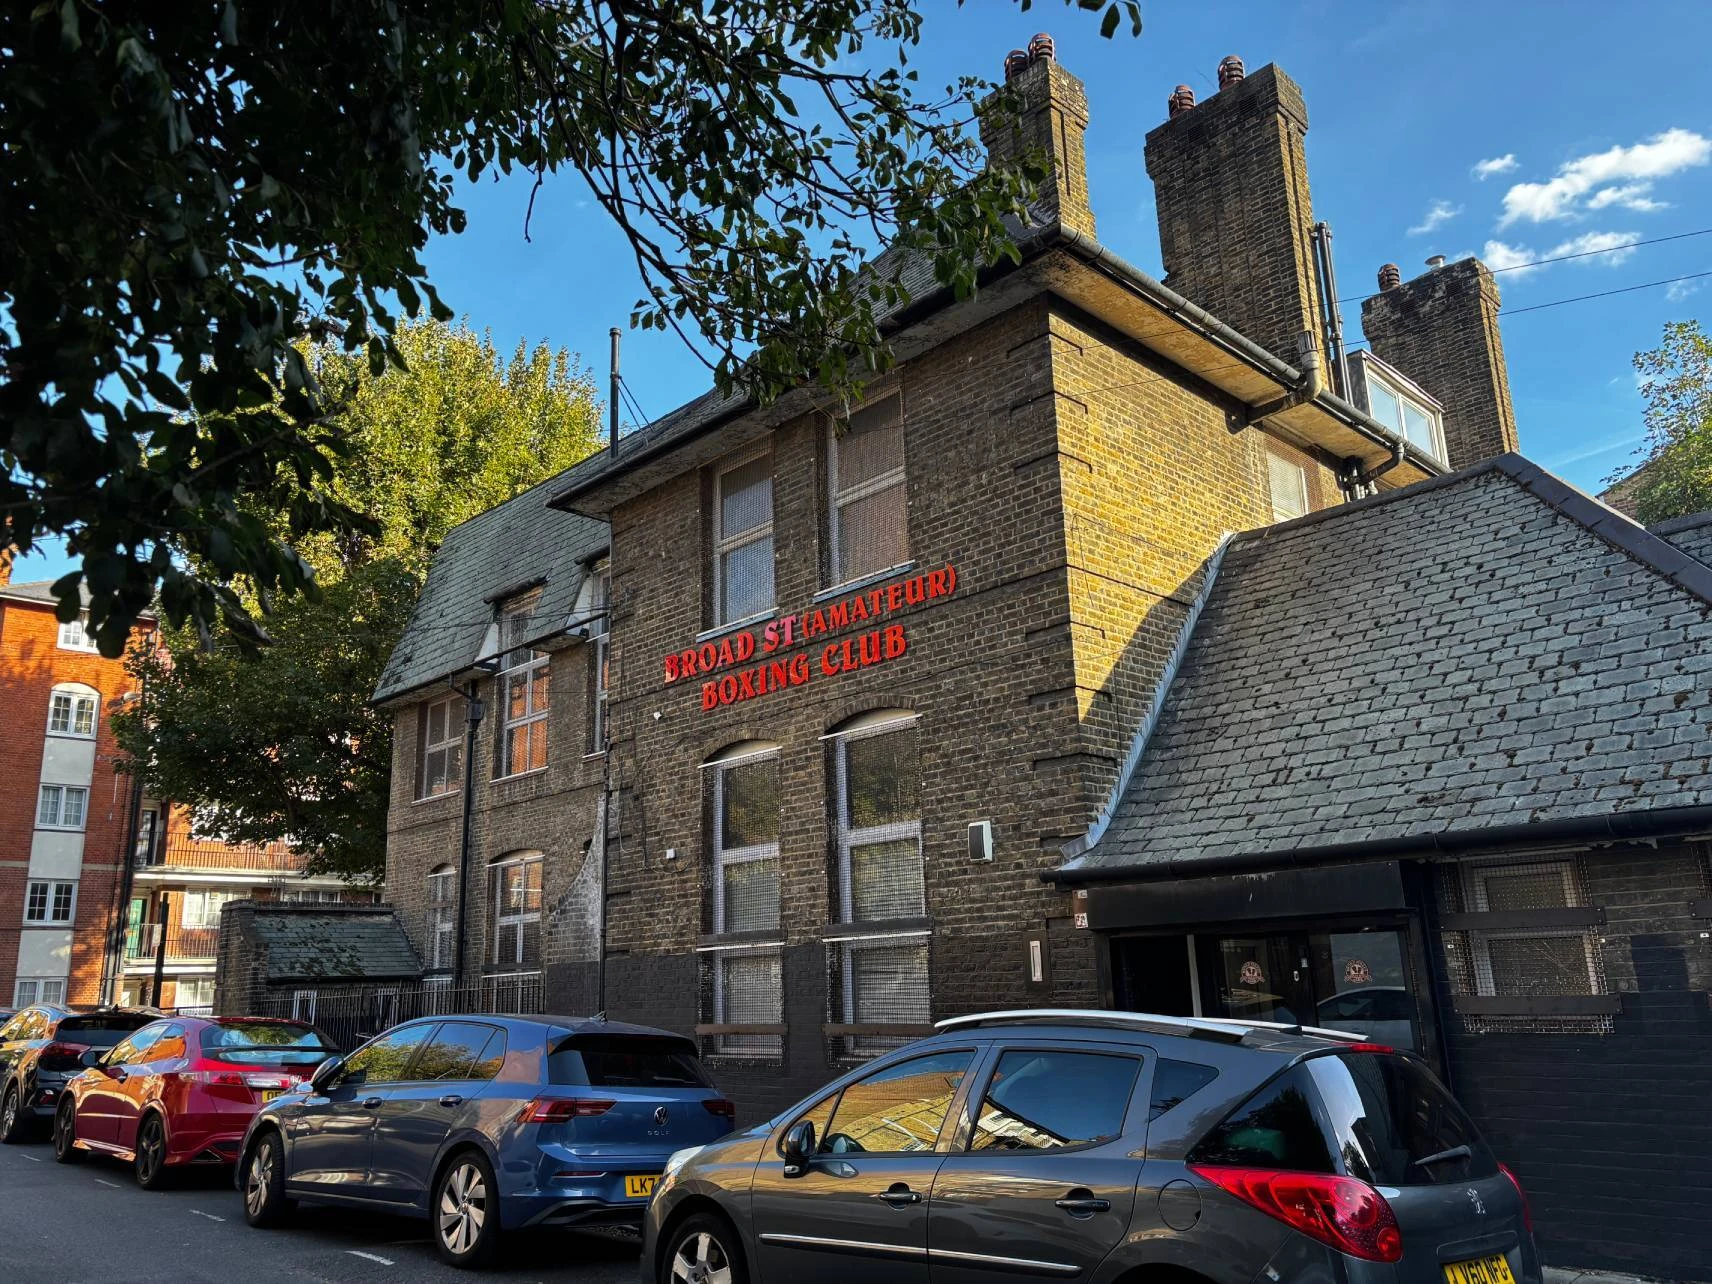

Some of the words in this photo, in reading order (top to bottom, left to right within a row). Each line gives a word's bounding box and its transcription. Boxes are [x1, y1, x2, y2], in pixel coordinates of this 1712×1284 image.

[664, 631, 755, 684] BROAD
[763, 614, 797, 653] ST
[802, 563, 957, 640] (AMATEUR)
[702, 653, 810, 711] BOXING
[821, 624, 907, 677] CLUB
[631, 1177, 661, 1194] LK7
